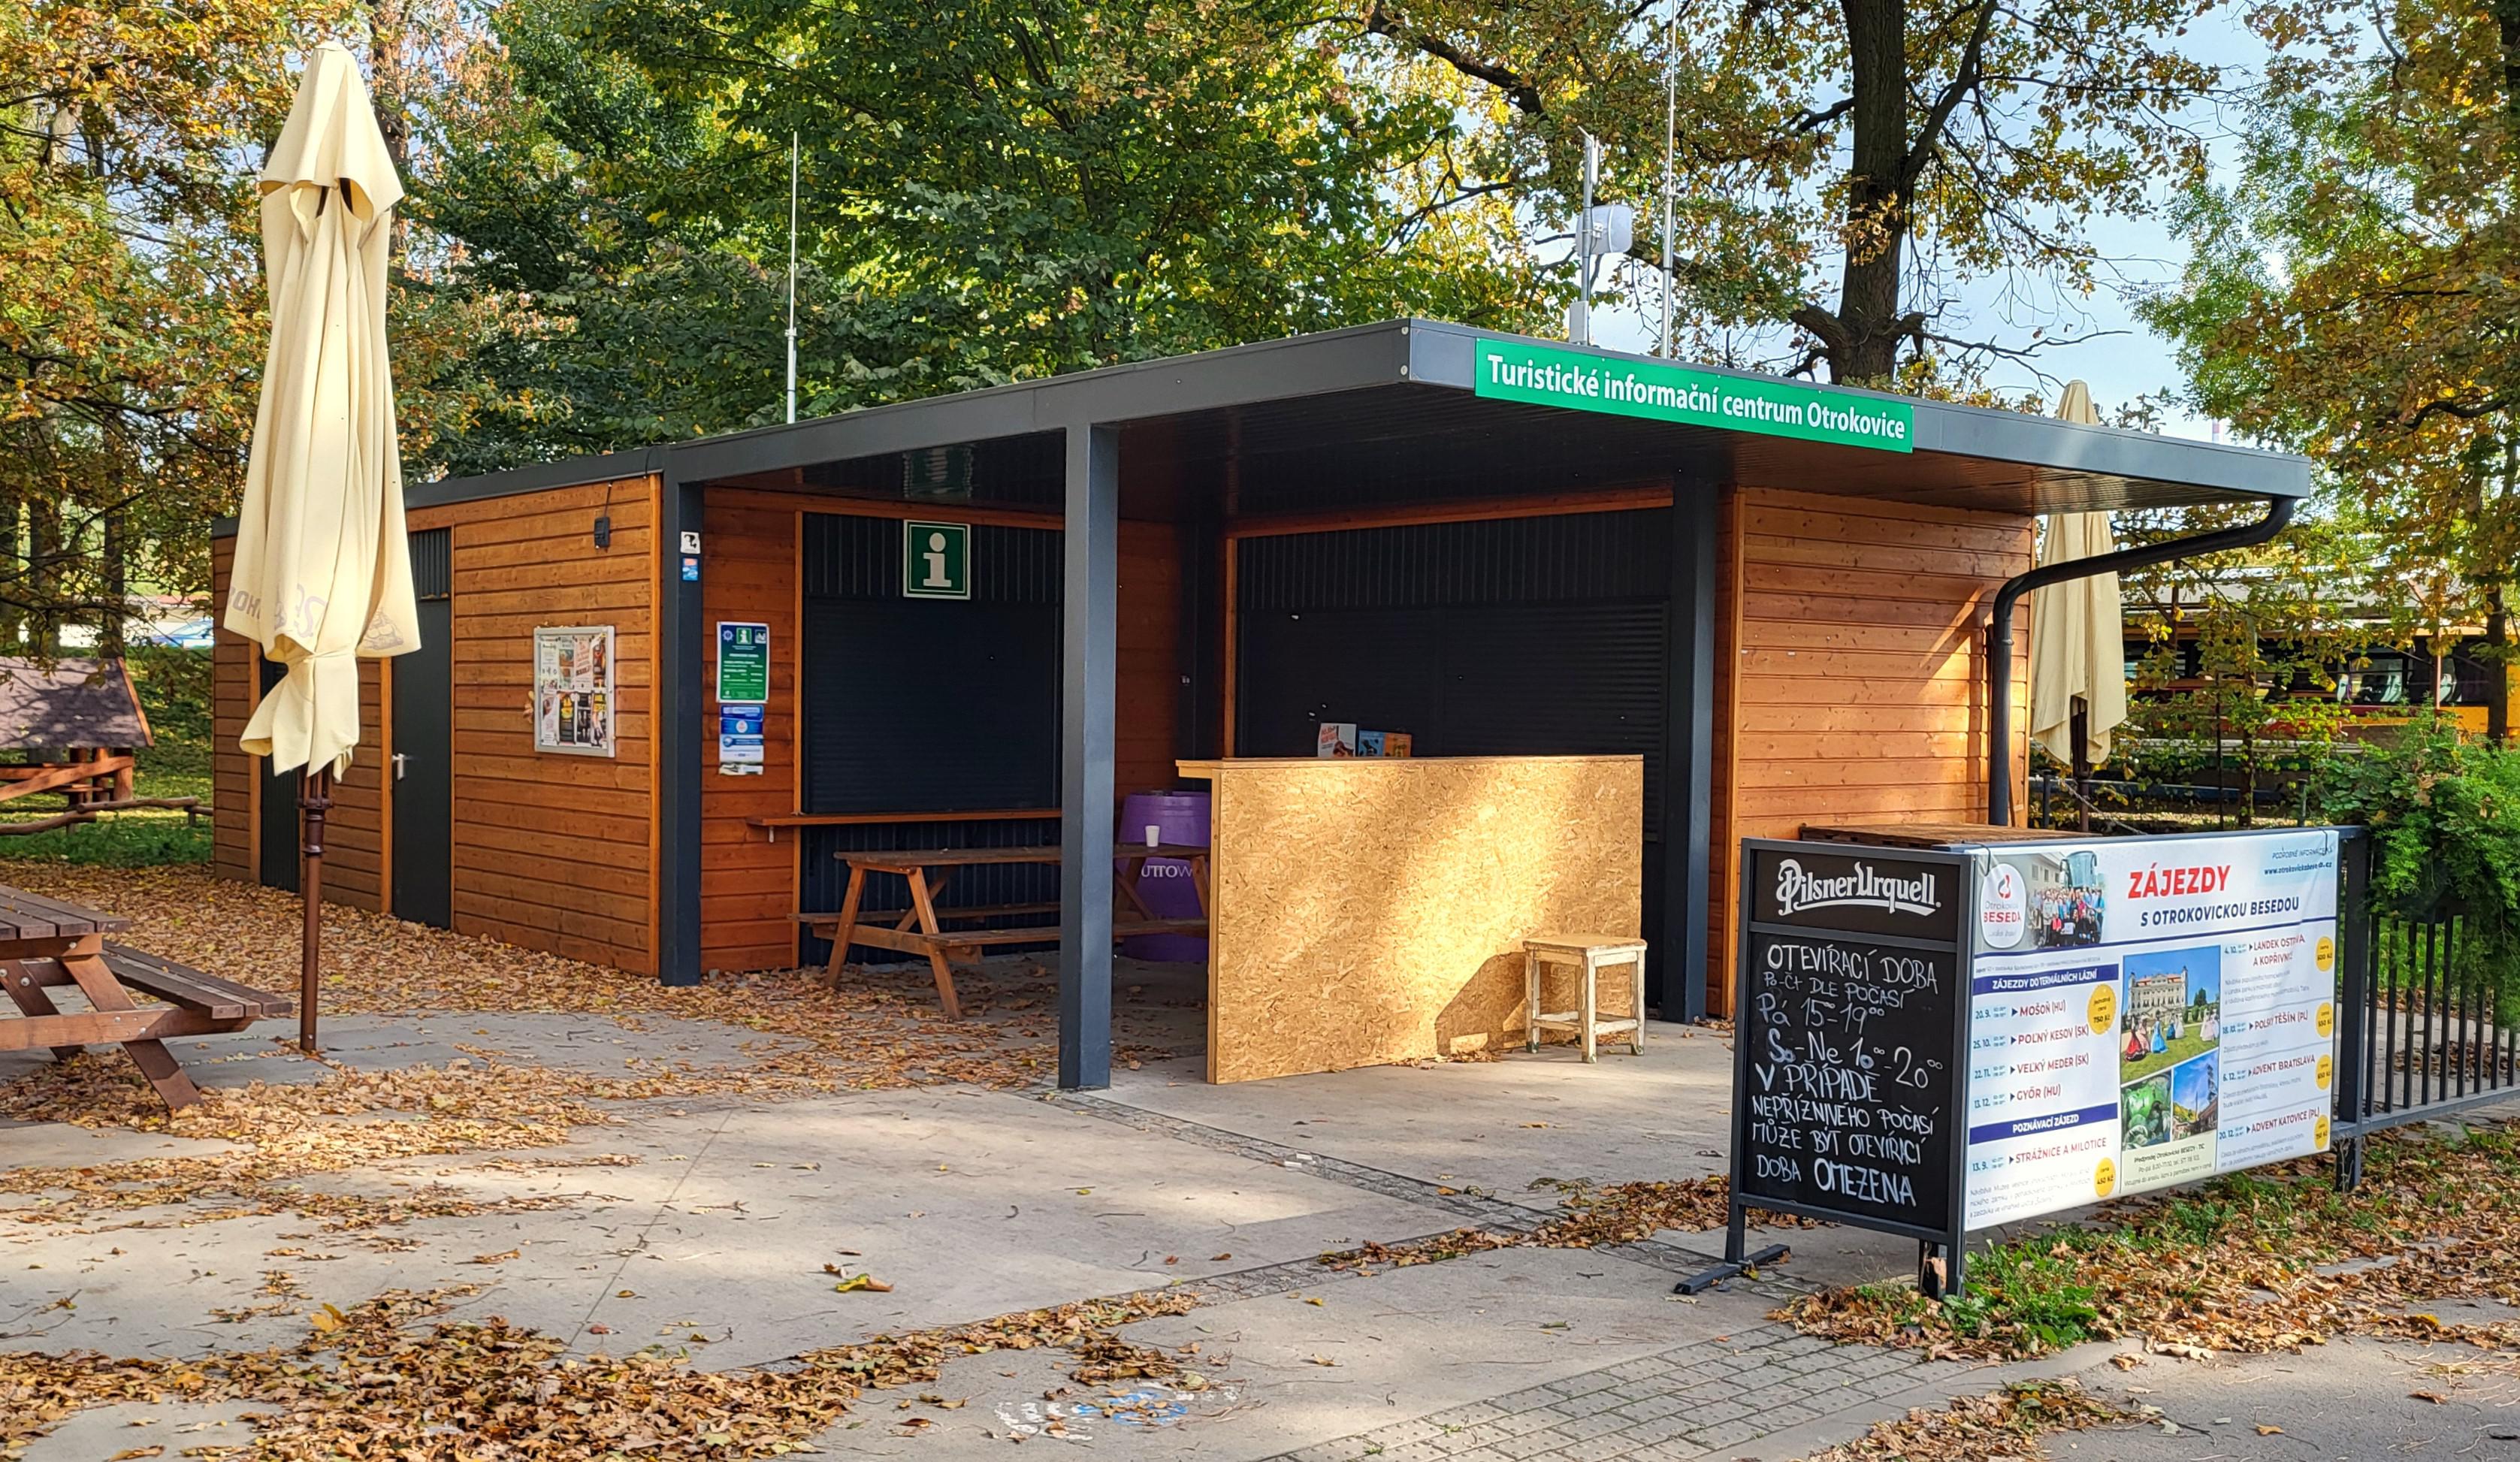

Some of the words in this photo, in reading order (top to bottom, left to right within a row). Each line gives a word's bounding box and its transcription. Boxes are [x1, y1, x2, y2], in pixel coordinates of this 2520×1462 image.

[1488, 355, 1599, 397] Turistické
[1605, 368, 1718, 413] informační
[1723, 397, 1802, 425] centrum
[1807, 402, 1905, 440] Otrokovice
[1776, 859, 1857, 916] Pilsner
[1854, 862, 1935, 914] Urquell
[2128, 862, 2231, 899] ZÁJEZDY
[2141, 912, 2148, 926] S
[2153, 902, 2247, 926] OTROKOVICKOU
[2250, 896, 2299, 915] BESEDOU
[2254, 939, 2279, 951] LANDEK
[1768, 944, 1878, 981] OTEVÍRACÍ
[1880, 956, 1938, 995] DOBA
[1993, 978, 2029, 989] ZÁJEZDY
[2029, 977, 2038, 987] DO
[2079, 968, 2098, 980] LÁZNÍ
[1809, 977, 1839, 996] DLE
[1845, 983, 1915, 1008] POČASÍ
[2020, 1001, 2050, 1016] MOŠOŇ
[2052, 999, 2066, 1014] (HU)
[1756, 993, 1791, 1027] Pá
[2050, 1027, 2074, 1041] KESOV
[2074, 1024, 2089, 1037] (SK)
[2047, 1056, 2074, 1071] MEDER
[2074, 1053, 2089, 1068] (SK)
[2279, 1054, 2316, 1071] BRATISLAVA
[1755, 1063, 1775, 1091] V
[1783, 1059, 1883, 1102] PŘÍPADĚ
[2044, 1084, 2061, 1098] (HU)
[1752, 1093, 1870, 1128] NEPŘÍZNIVÉHO
[1877, 1104, 1939, 1134] POČASÍ
[2013, 1118, 2053, 1134] POZNÁVACÍ
[2054, 1113, 2079, 1127] ZÁJEZD
[2251, 1119, 2277, 1132] ADVENT
[2279, 1110, 2307, 1125] KATOVICE
[1752, 1118, 1802, 1149] MŮŽE
[1809, 1126, 1842, 1155] BÝT
[1849, 1130, 1926, 1164] OTEVÍRACÍ
[2016, 1145, 2061, 1164] STRÁŽNICE
[2063, 1145, 2068, 1155] A
[2071, 1137, 2107, 1153] MILOTICE
[1757, 1154, 1802, 1182] DOBA
[1814, 1158, 1917, 1207] OMEZENA
